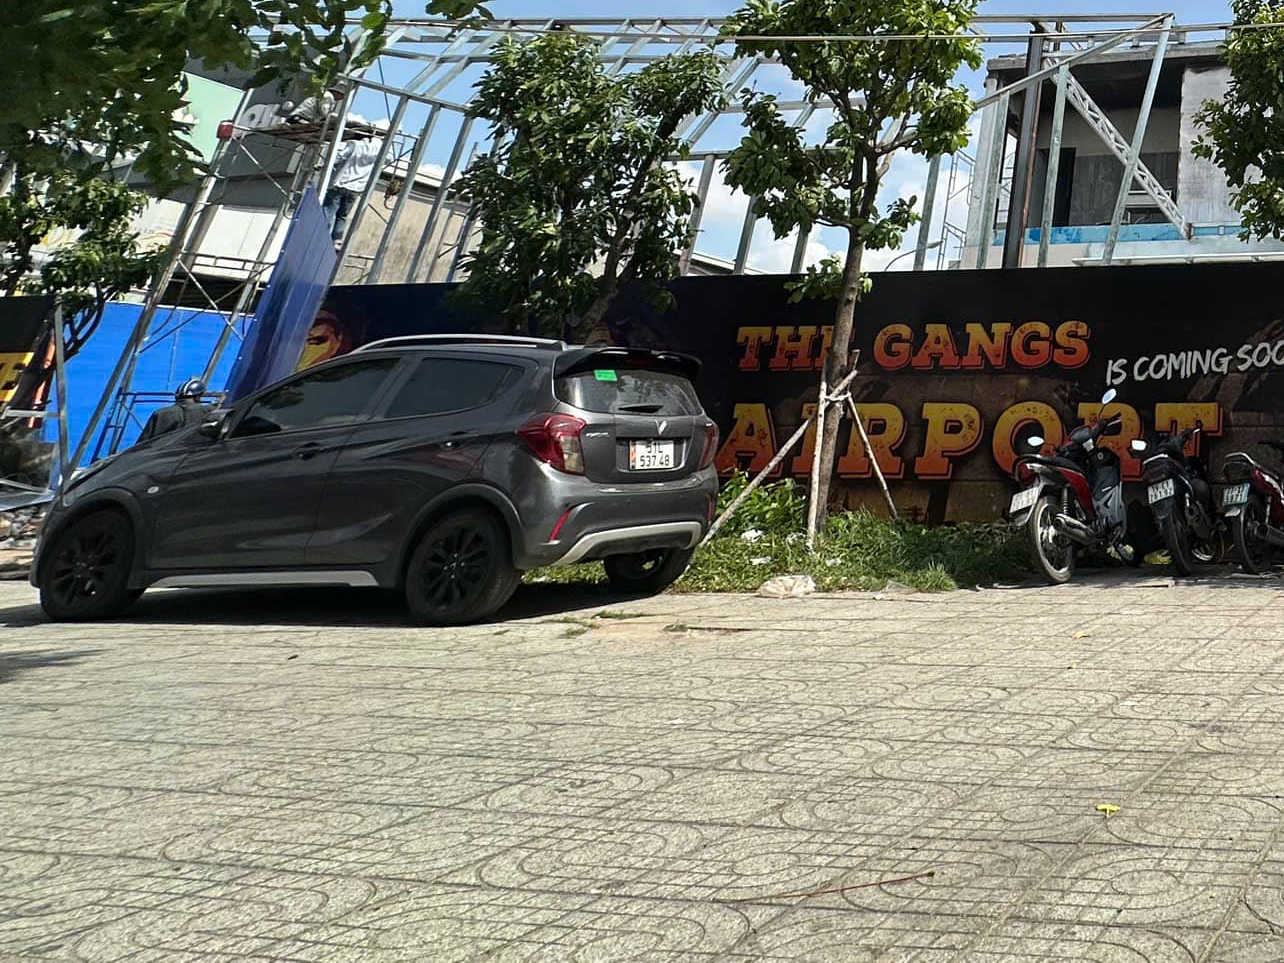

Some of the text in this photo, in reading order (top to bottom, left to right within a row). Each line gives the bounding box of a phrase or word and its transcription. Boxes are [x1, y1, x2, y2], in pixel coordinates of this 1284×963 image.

[873, 320, 1092, 372] GANGS
[1106, 358, 1128, 386] IS
[1133, 347, 1232, 381] COMING
[640, 454, 670, 468] 537.48
